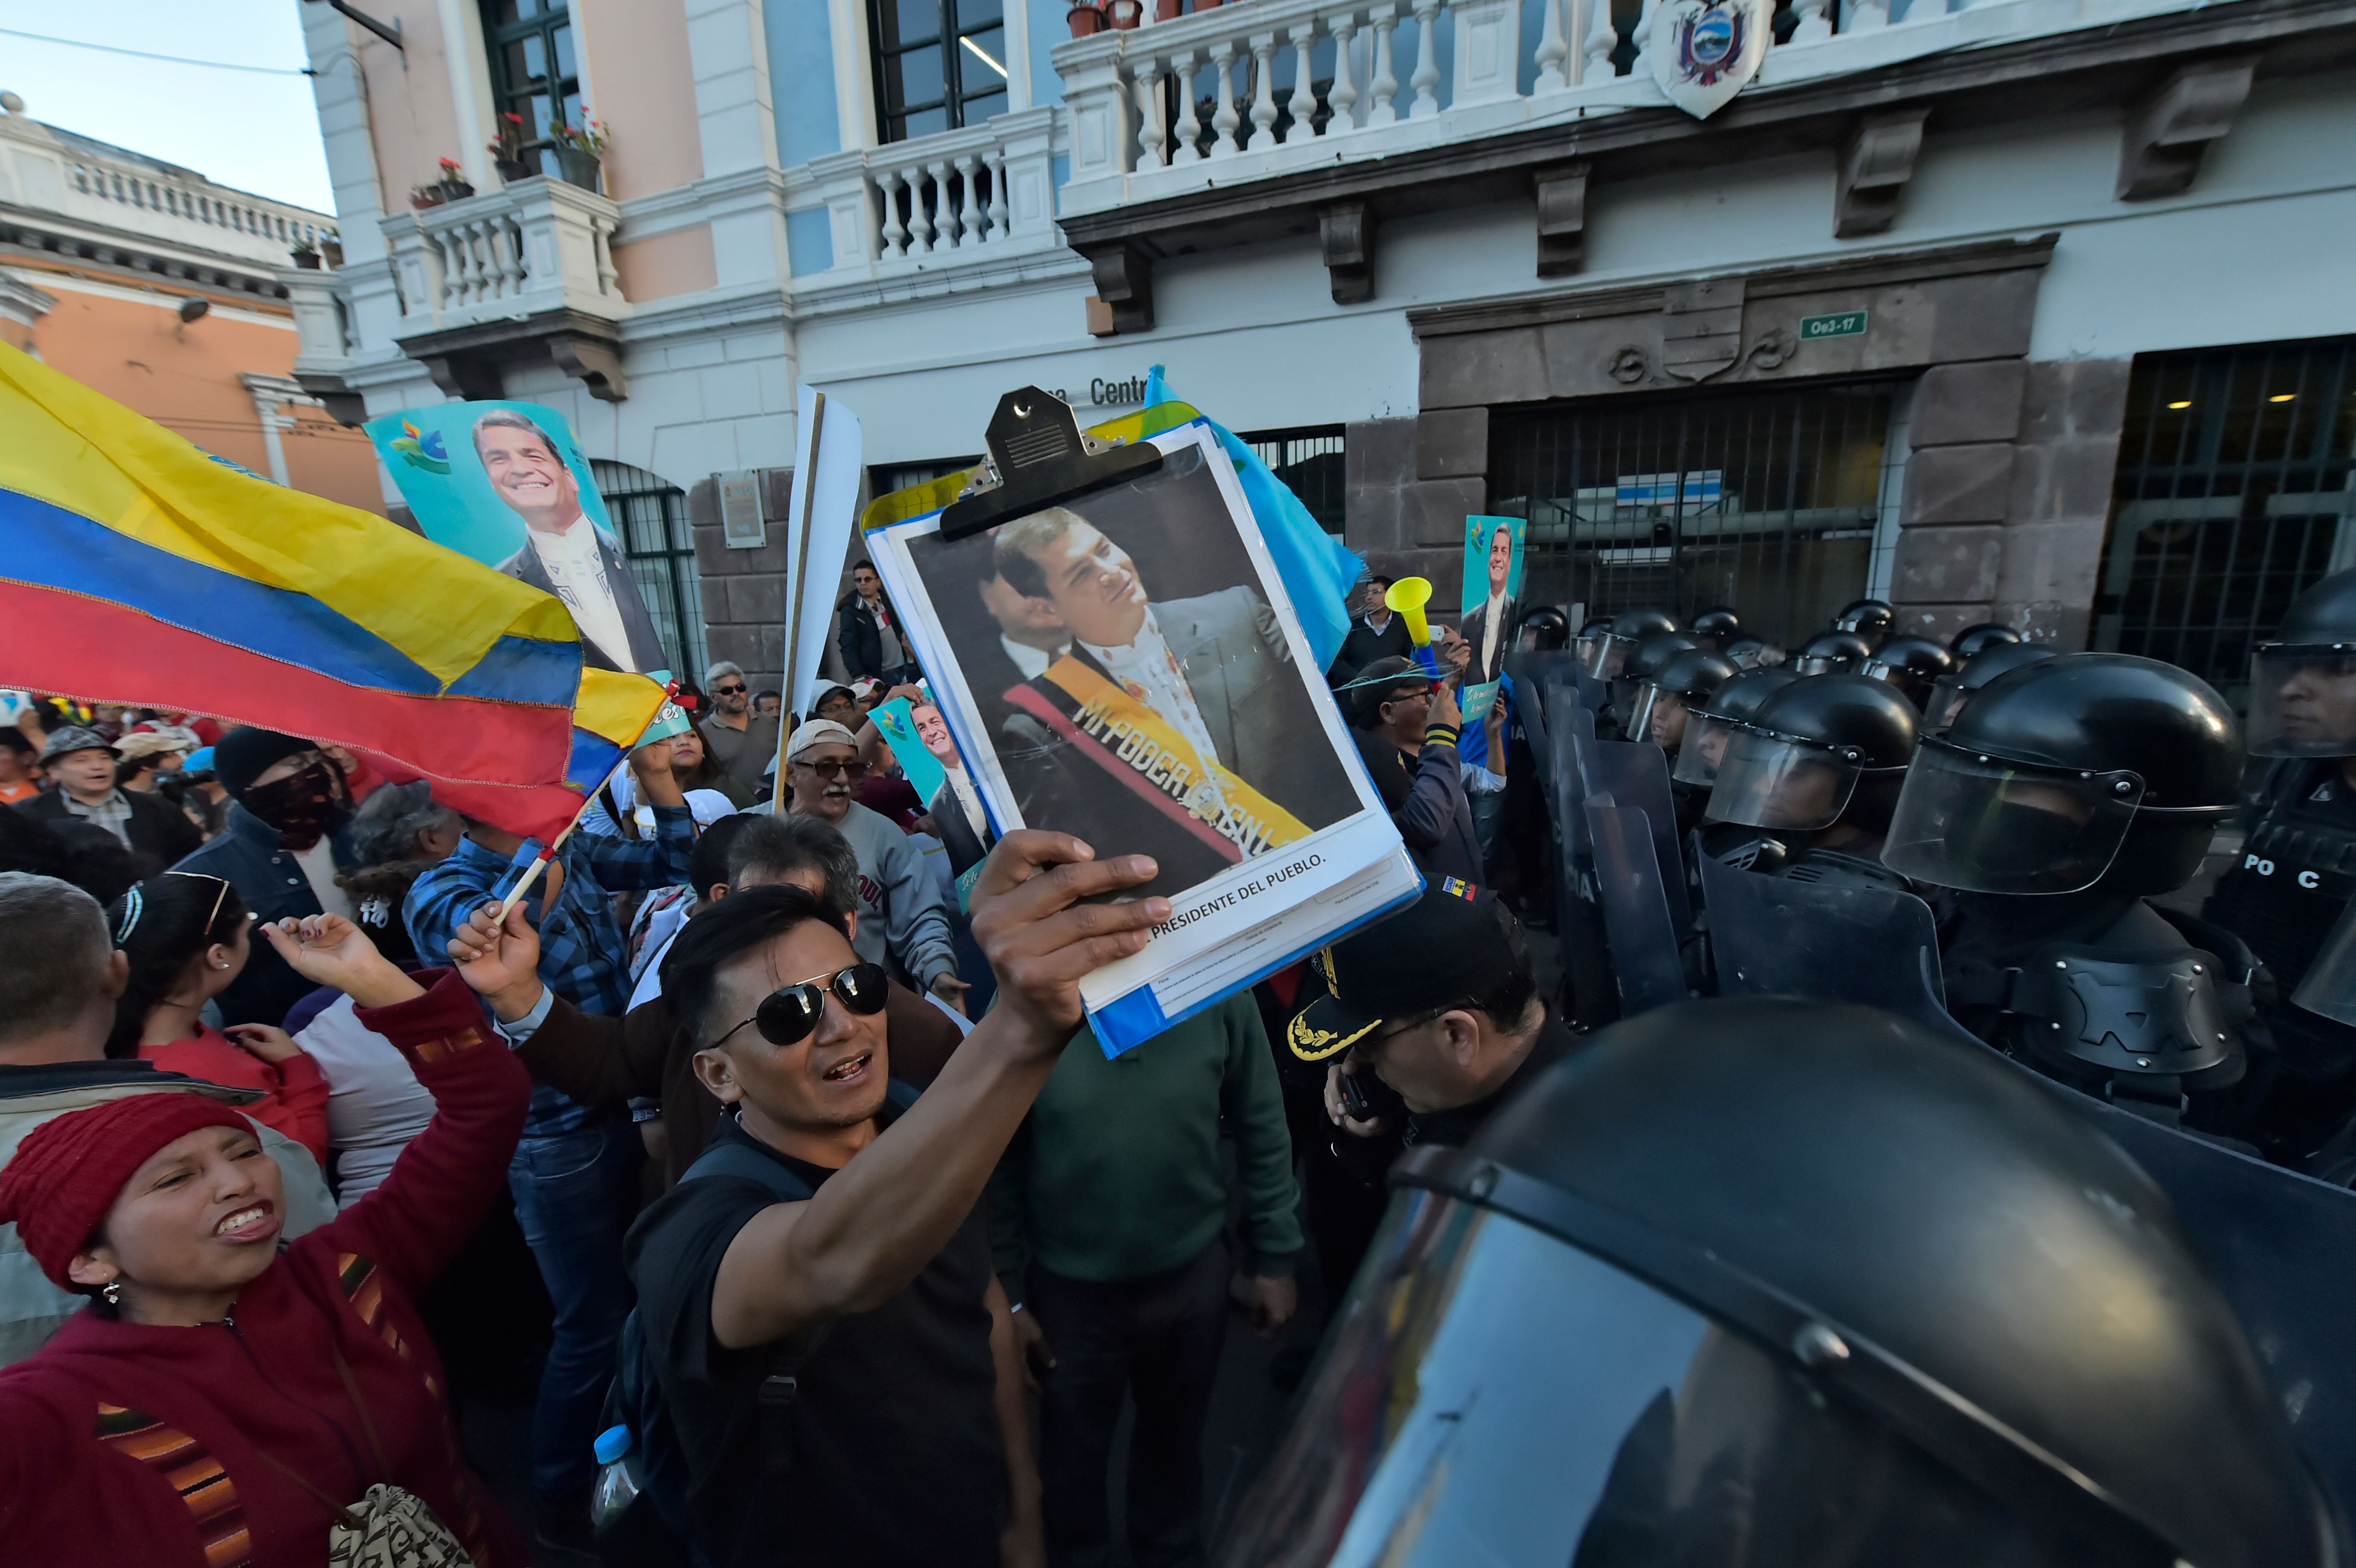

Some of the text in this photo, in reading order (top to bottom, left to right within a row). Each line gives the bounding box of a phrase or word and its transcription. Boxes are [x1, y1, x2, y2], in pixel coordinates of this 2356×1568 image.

[1811, 317, 1855, 334] Oe3-17
[1091, 375, 1148, 405] Centr
[1101, 719, 1192, 797] PODER
[857, 874, 883, 912] OUL
[1151, 854, 1326, 939] PRESIDENTE DEL PUEBLO.
